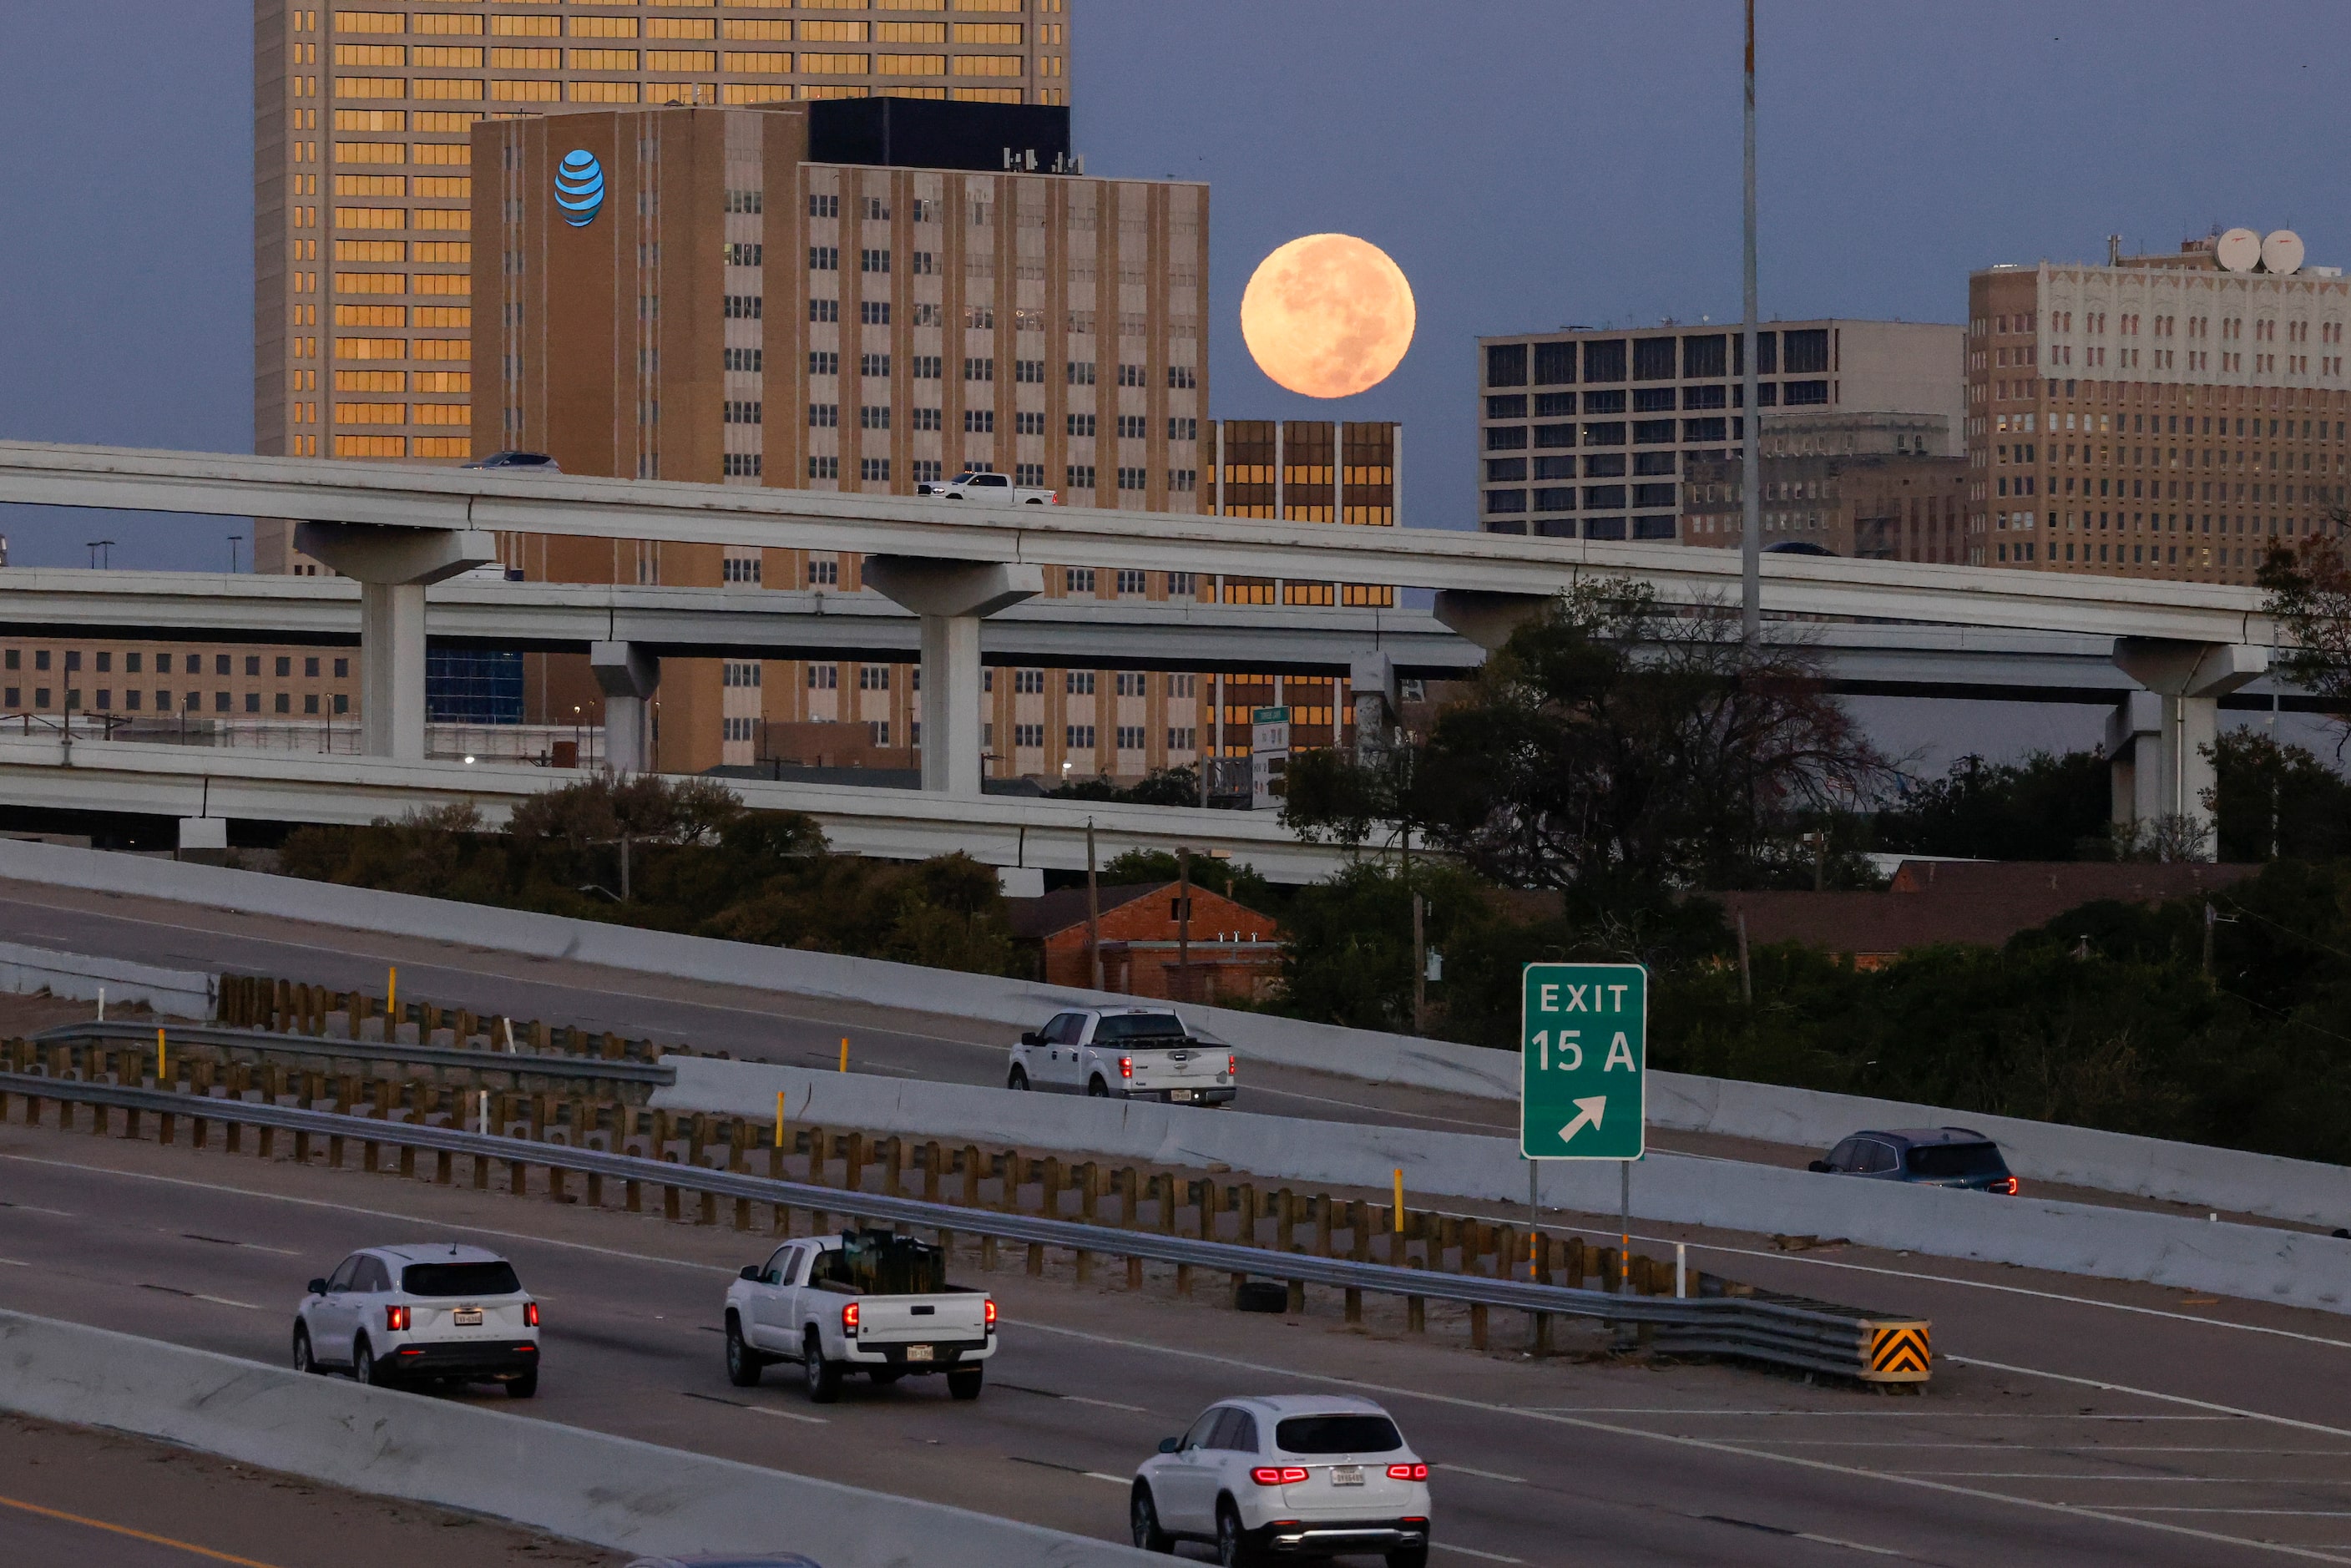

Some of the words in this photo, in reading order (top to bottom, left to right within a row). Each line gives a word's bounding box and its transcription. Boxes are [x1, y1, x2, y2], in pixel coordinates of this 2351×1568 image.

[1540, 984, 1628, 1012] EXIT
[1531, 1029, 1583, 1070] 15
[1603, 1031, 1636, 1072] A
